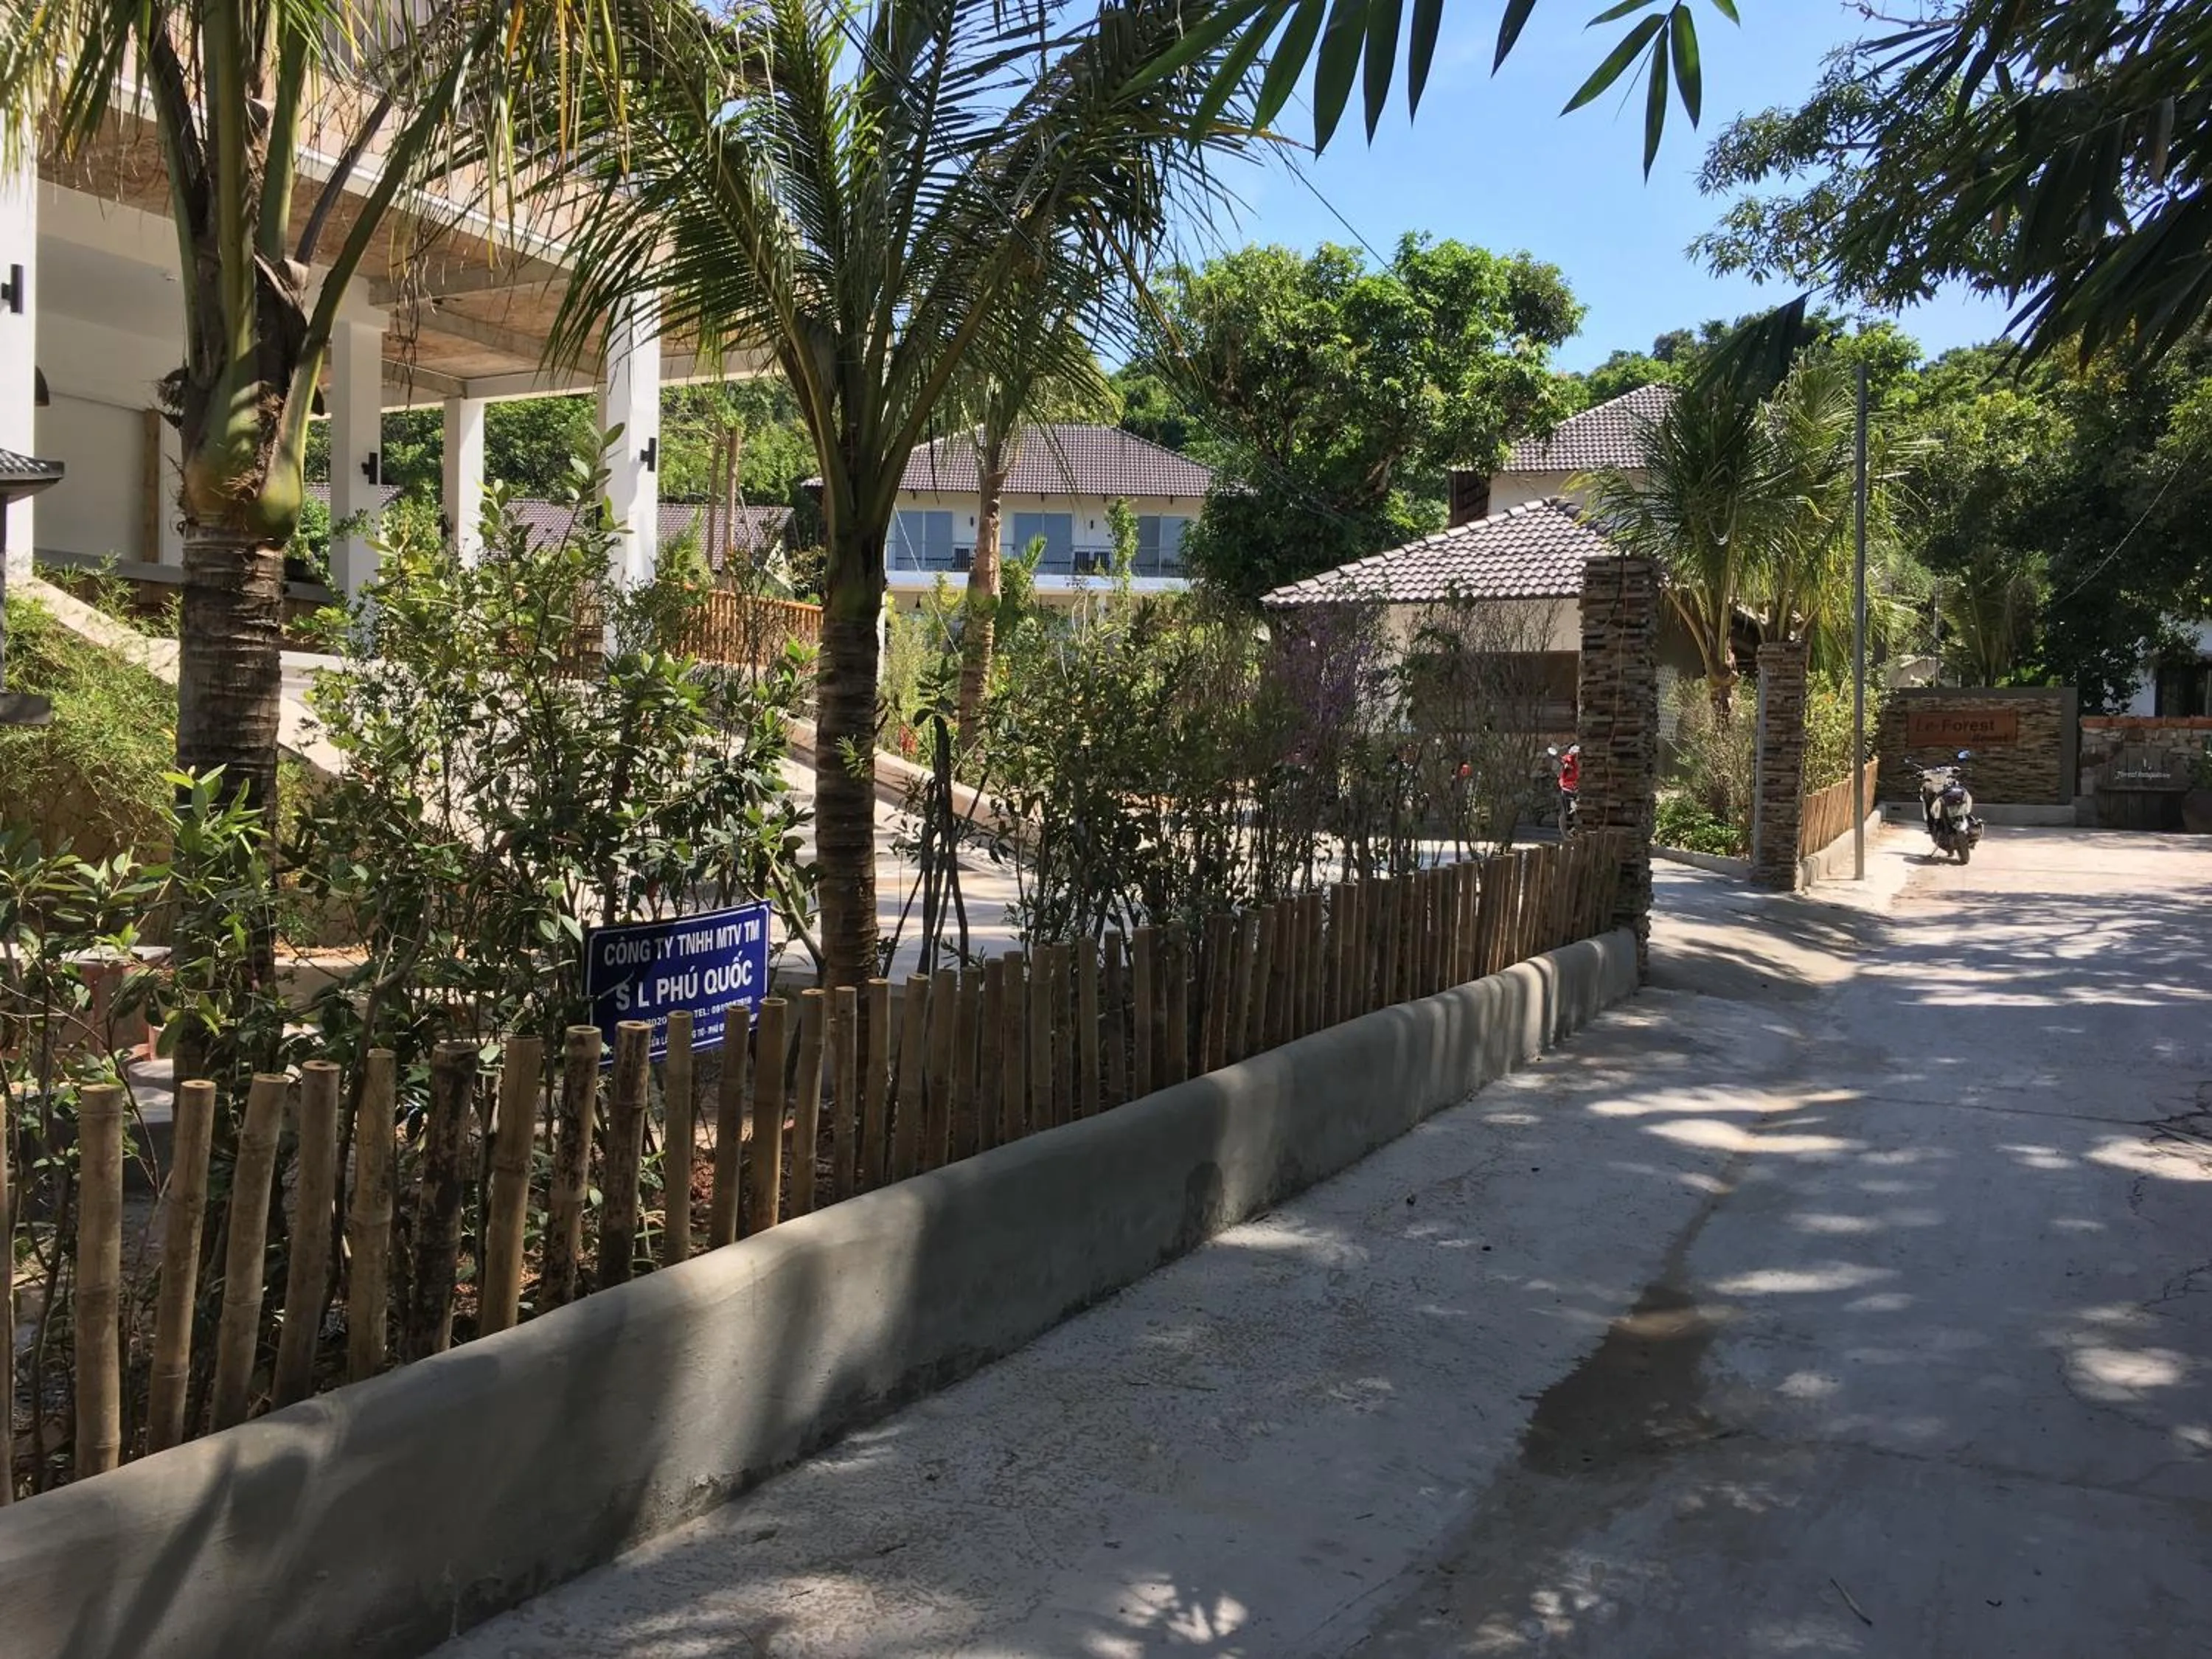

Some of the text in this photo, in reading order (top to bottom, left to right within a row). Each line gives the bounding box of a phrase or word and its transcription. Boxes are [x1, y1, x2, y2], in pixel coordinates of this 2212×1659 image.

[1941, 718, 1994, 732] Forest
[604, 919, 760, 966] CÔNG TY TNHH MTV TM
[656, 965, 698, 1005] PHÚ
[704, 950, 753, 995] QUỐC
